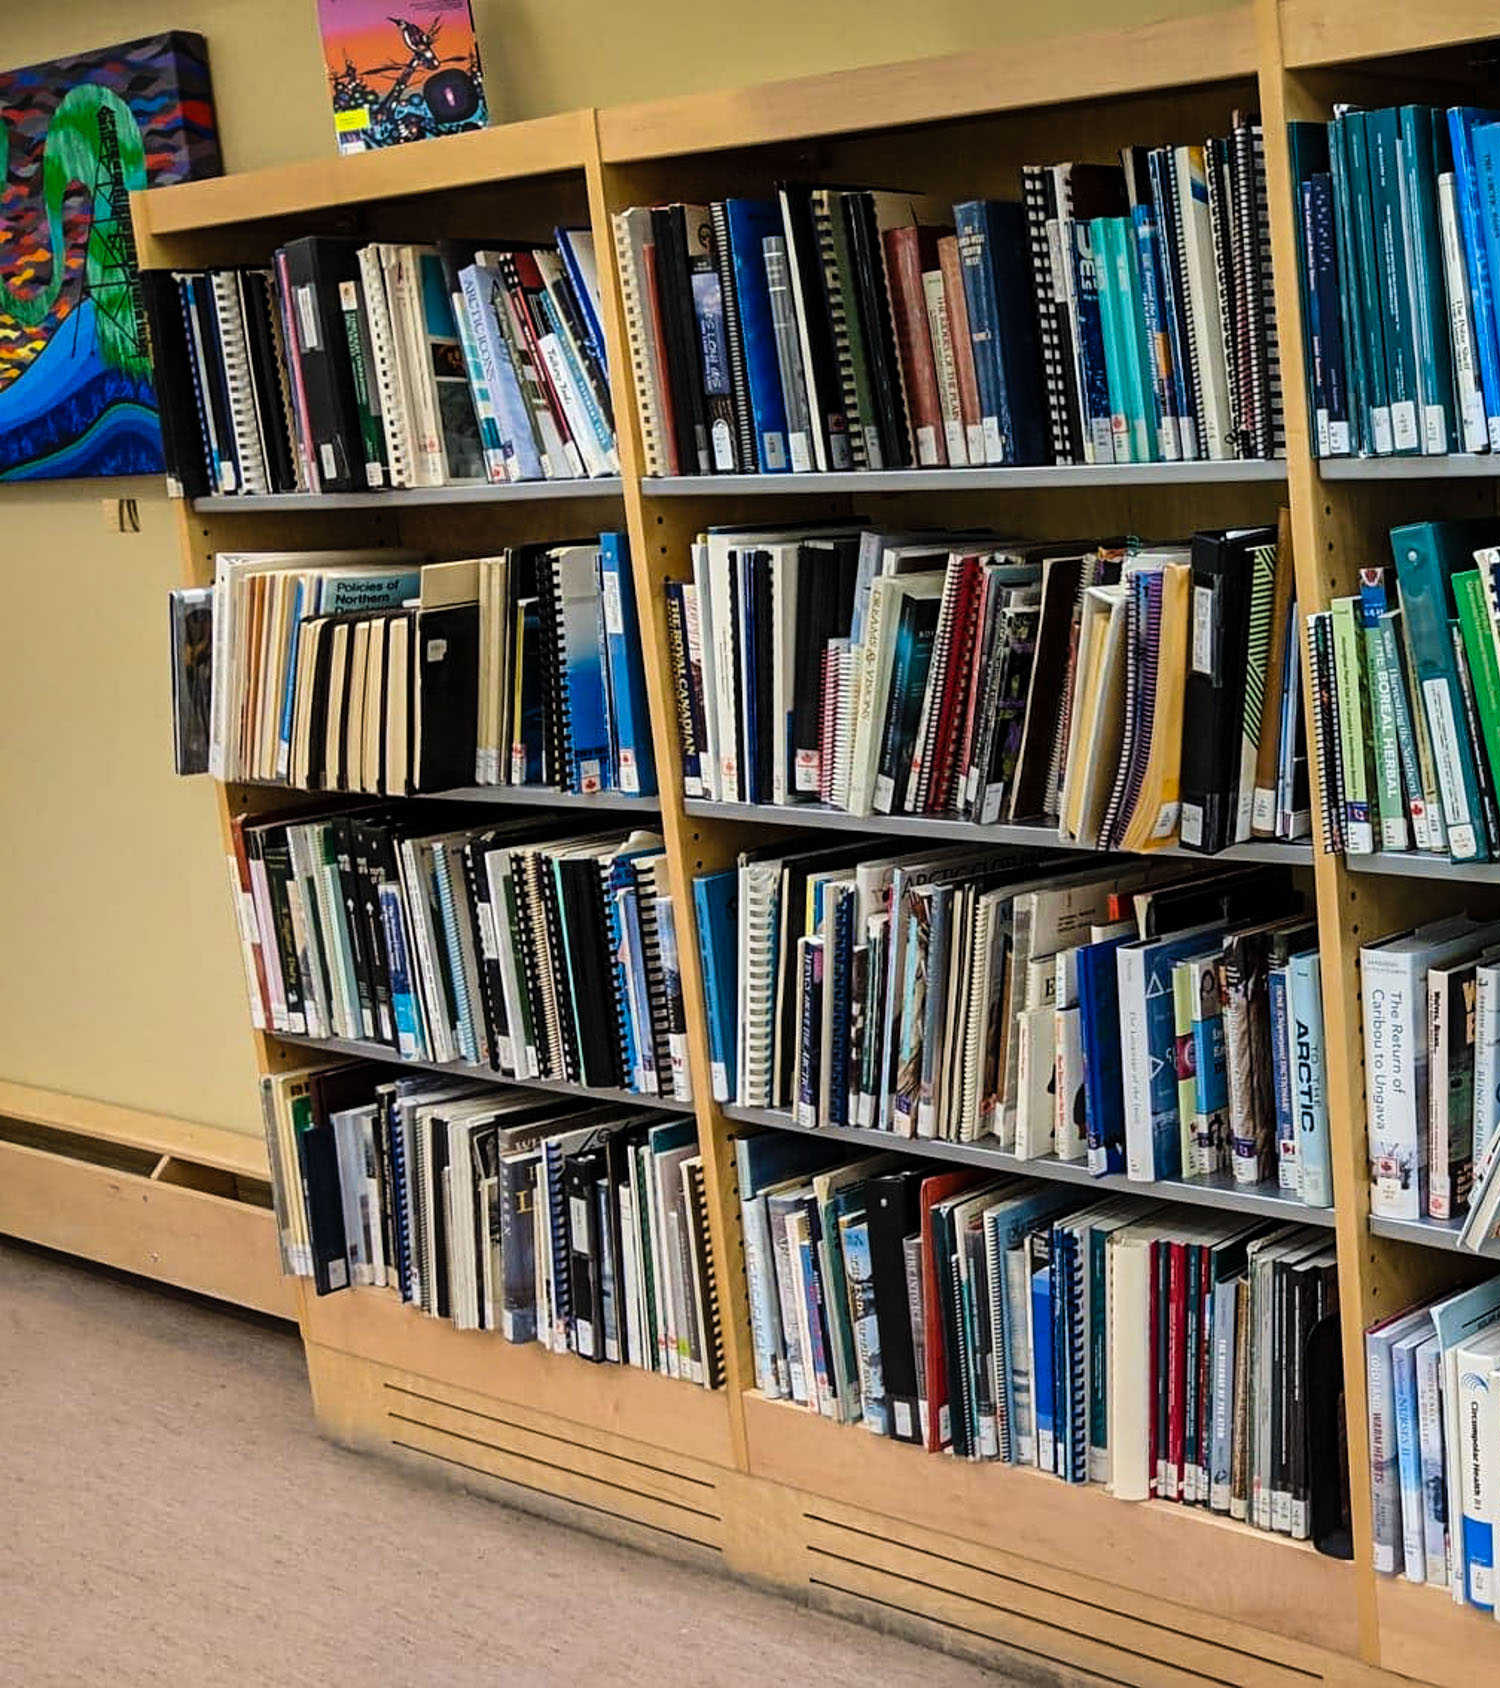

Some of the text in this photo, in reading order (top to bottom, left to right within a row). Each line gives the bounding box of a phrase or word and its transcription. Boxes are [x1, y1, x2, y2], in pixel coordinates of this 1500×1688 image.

[335, 594, 390, 605] Northern
[337, 579, 399, 593] Policies of
[668, 597, 698, 756] THE ROYAL CANADIAN
[1372, 637, 1386, 666] THE
[1371, 669, 1396, 734] BOREAL
[1377, 736, 1403, 799] HERBAL
[1295, 1018, 1315, 1132] ARCTIC
[1370, 988, 1389, 1130] Caribou to Ungava
[1389, 991, 1406, 1096] The Return of
[1467, 1400, 1482, 1496] Circumpolar Health
